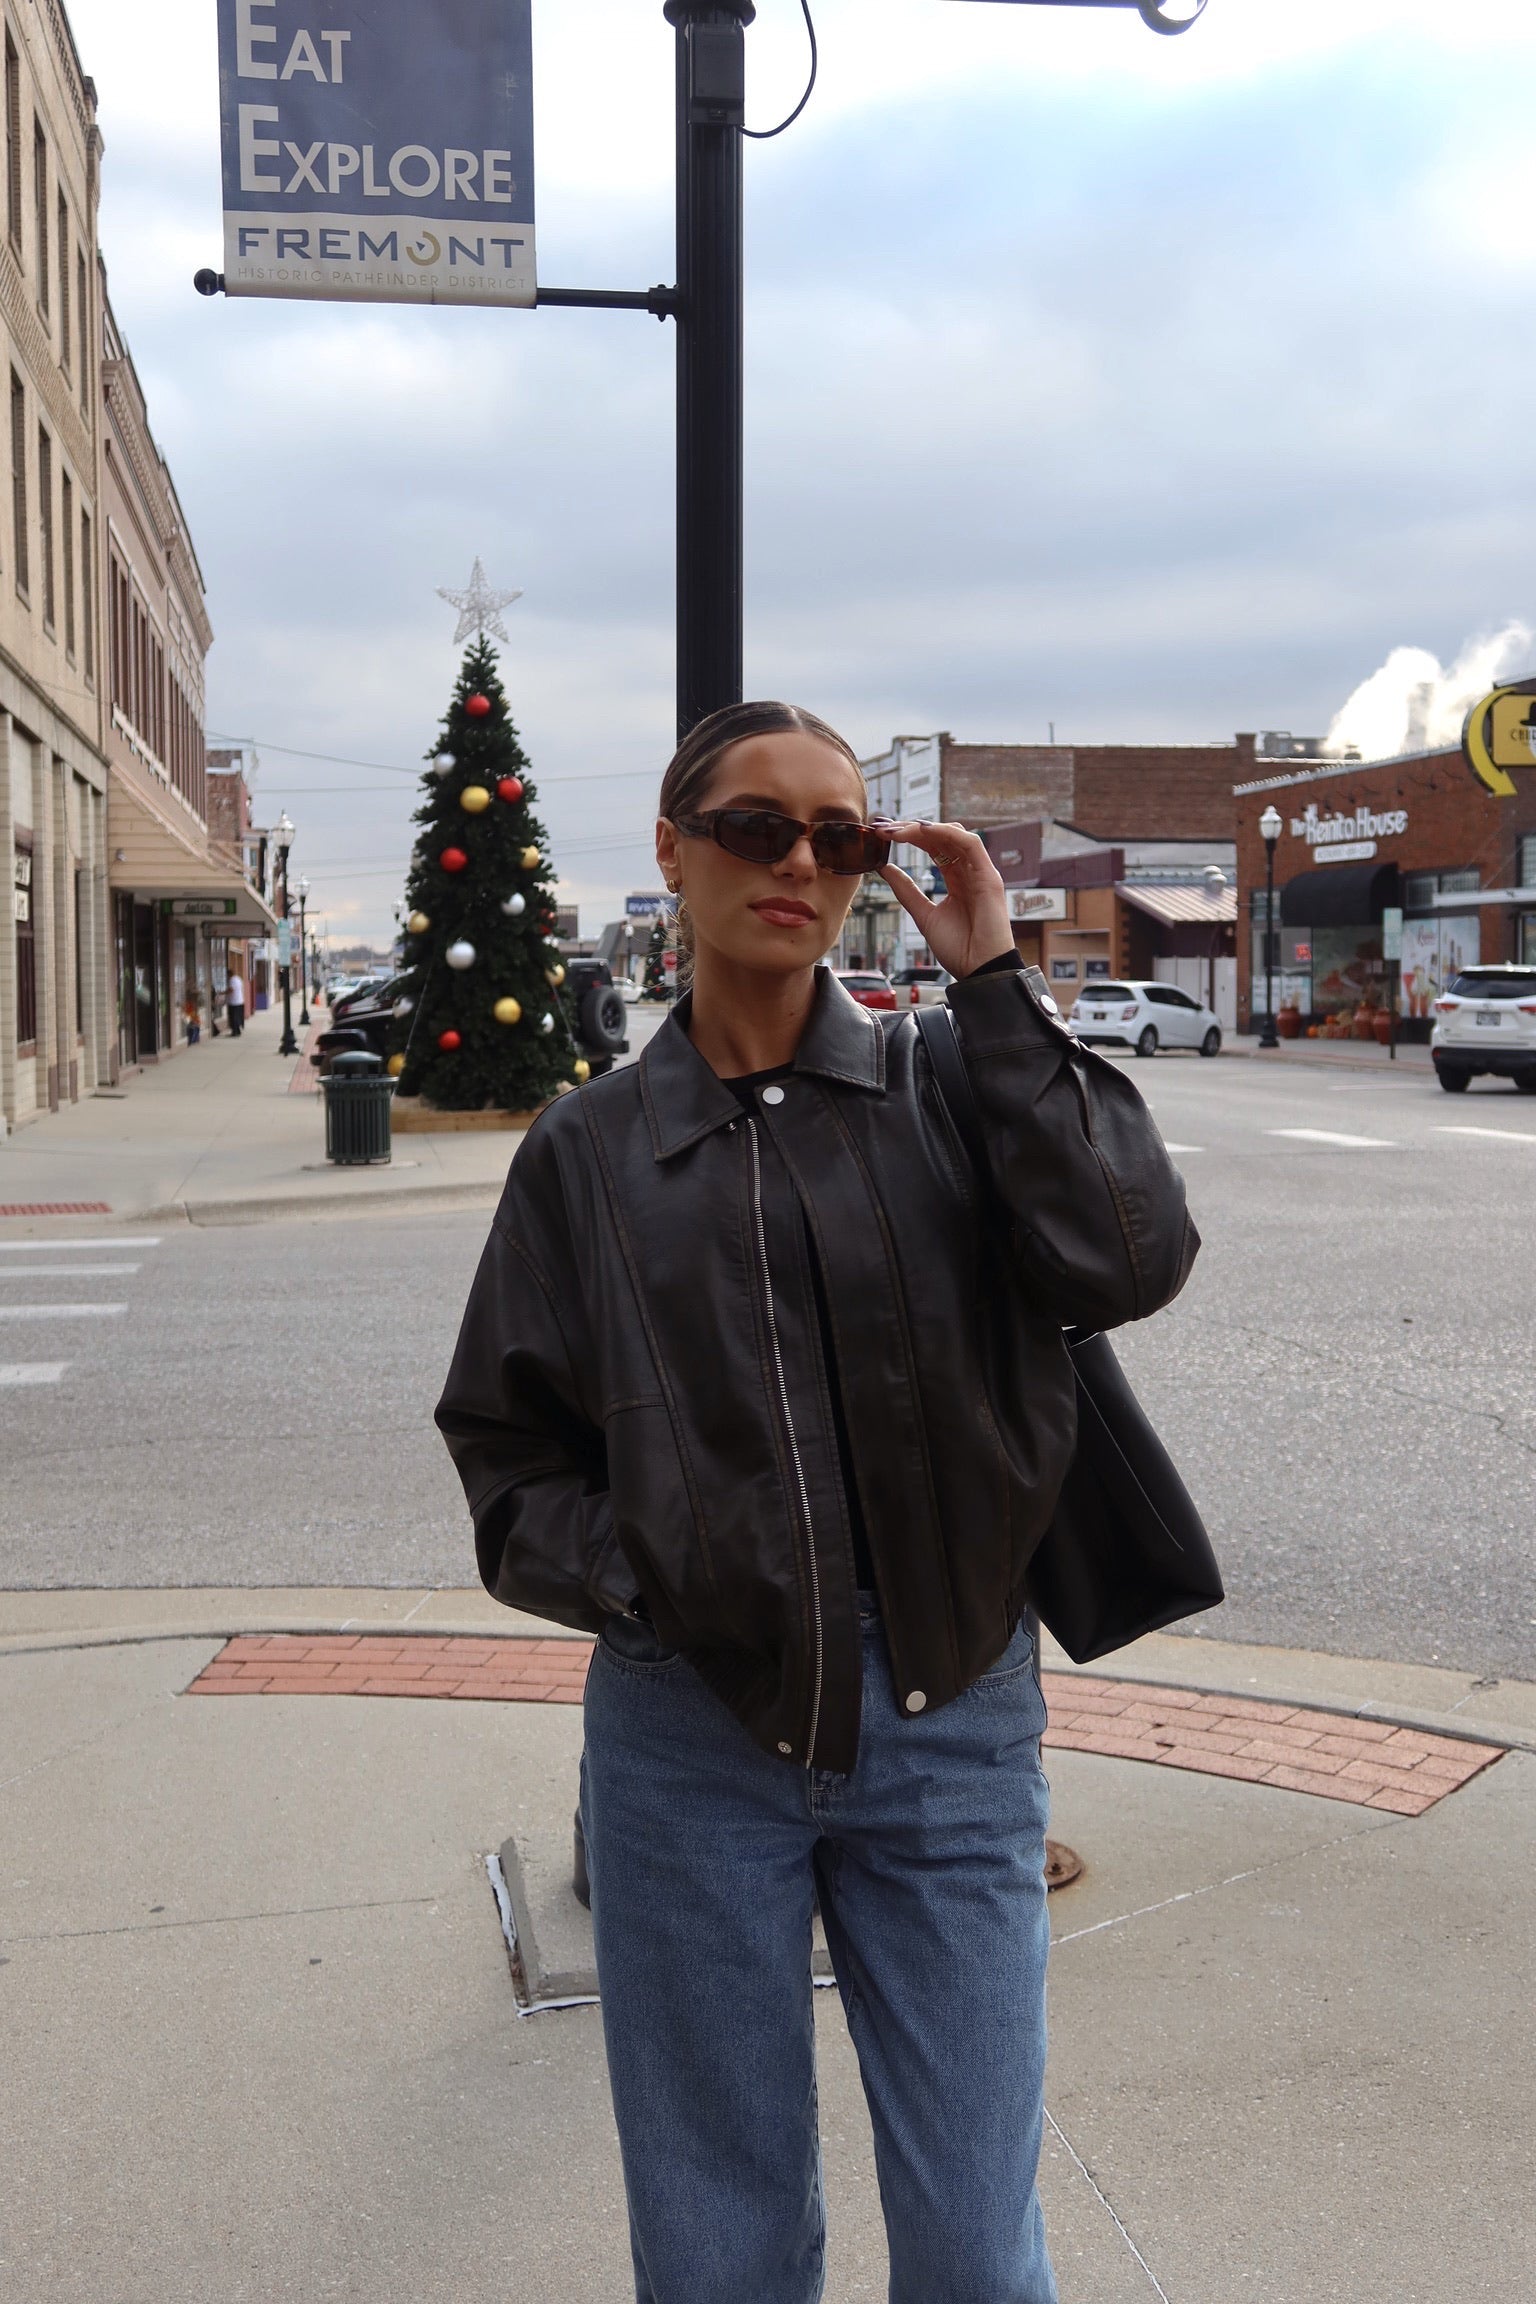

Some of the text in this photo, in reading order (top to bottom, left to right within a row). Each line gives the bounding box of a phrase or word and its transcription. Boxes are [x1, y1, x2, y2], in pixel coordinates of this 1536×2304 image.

[236, 0, 352, 84] EAT
[238, 103, 512, 203] EXPLORE
[238, 227, 525, 268] FREMONT
[238, 267, 526, 289] HISTORIC PATHFINDER DISTRICT
[1356, 806, 1408, 838] House
